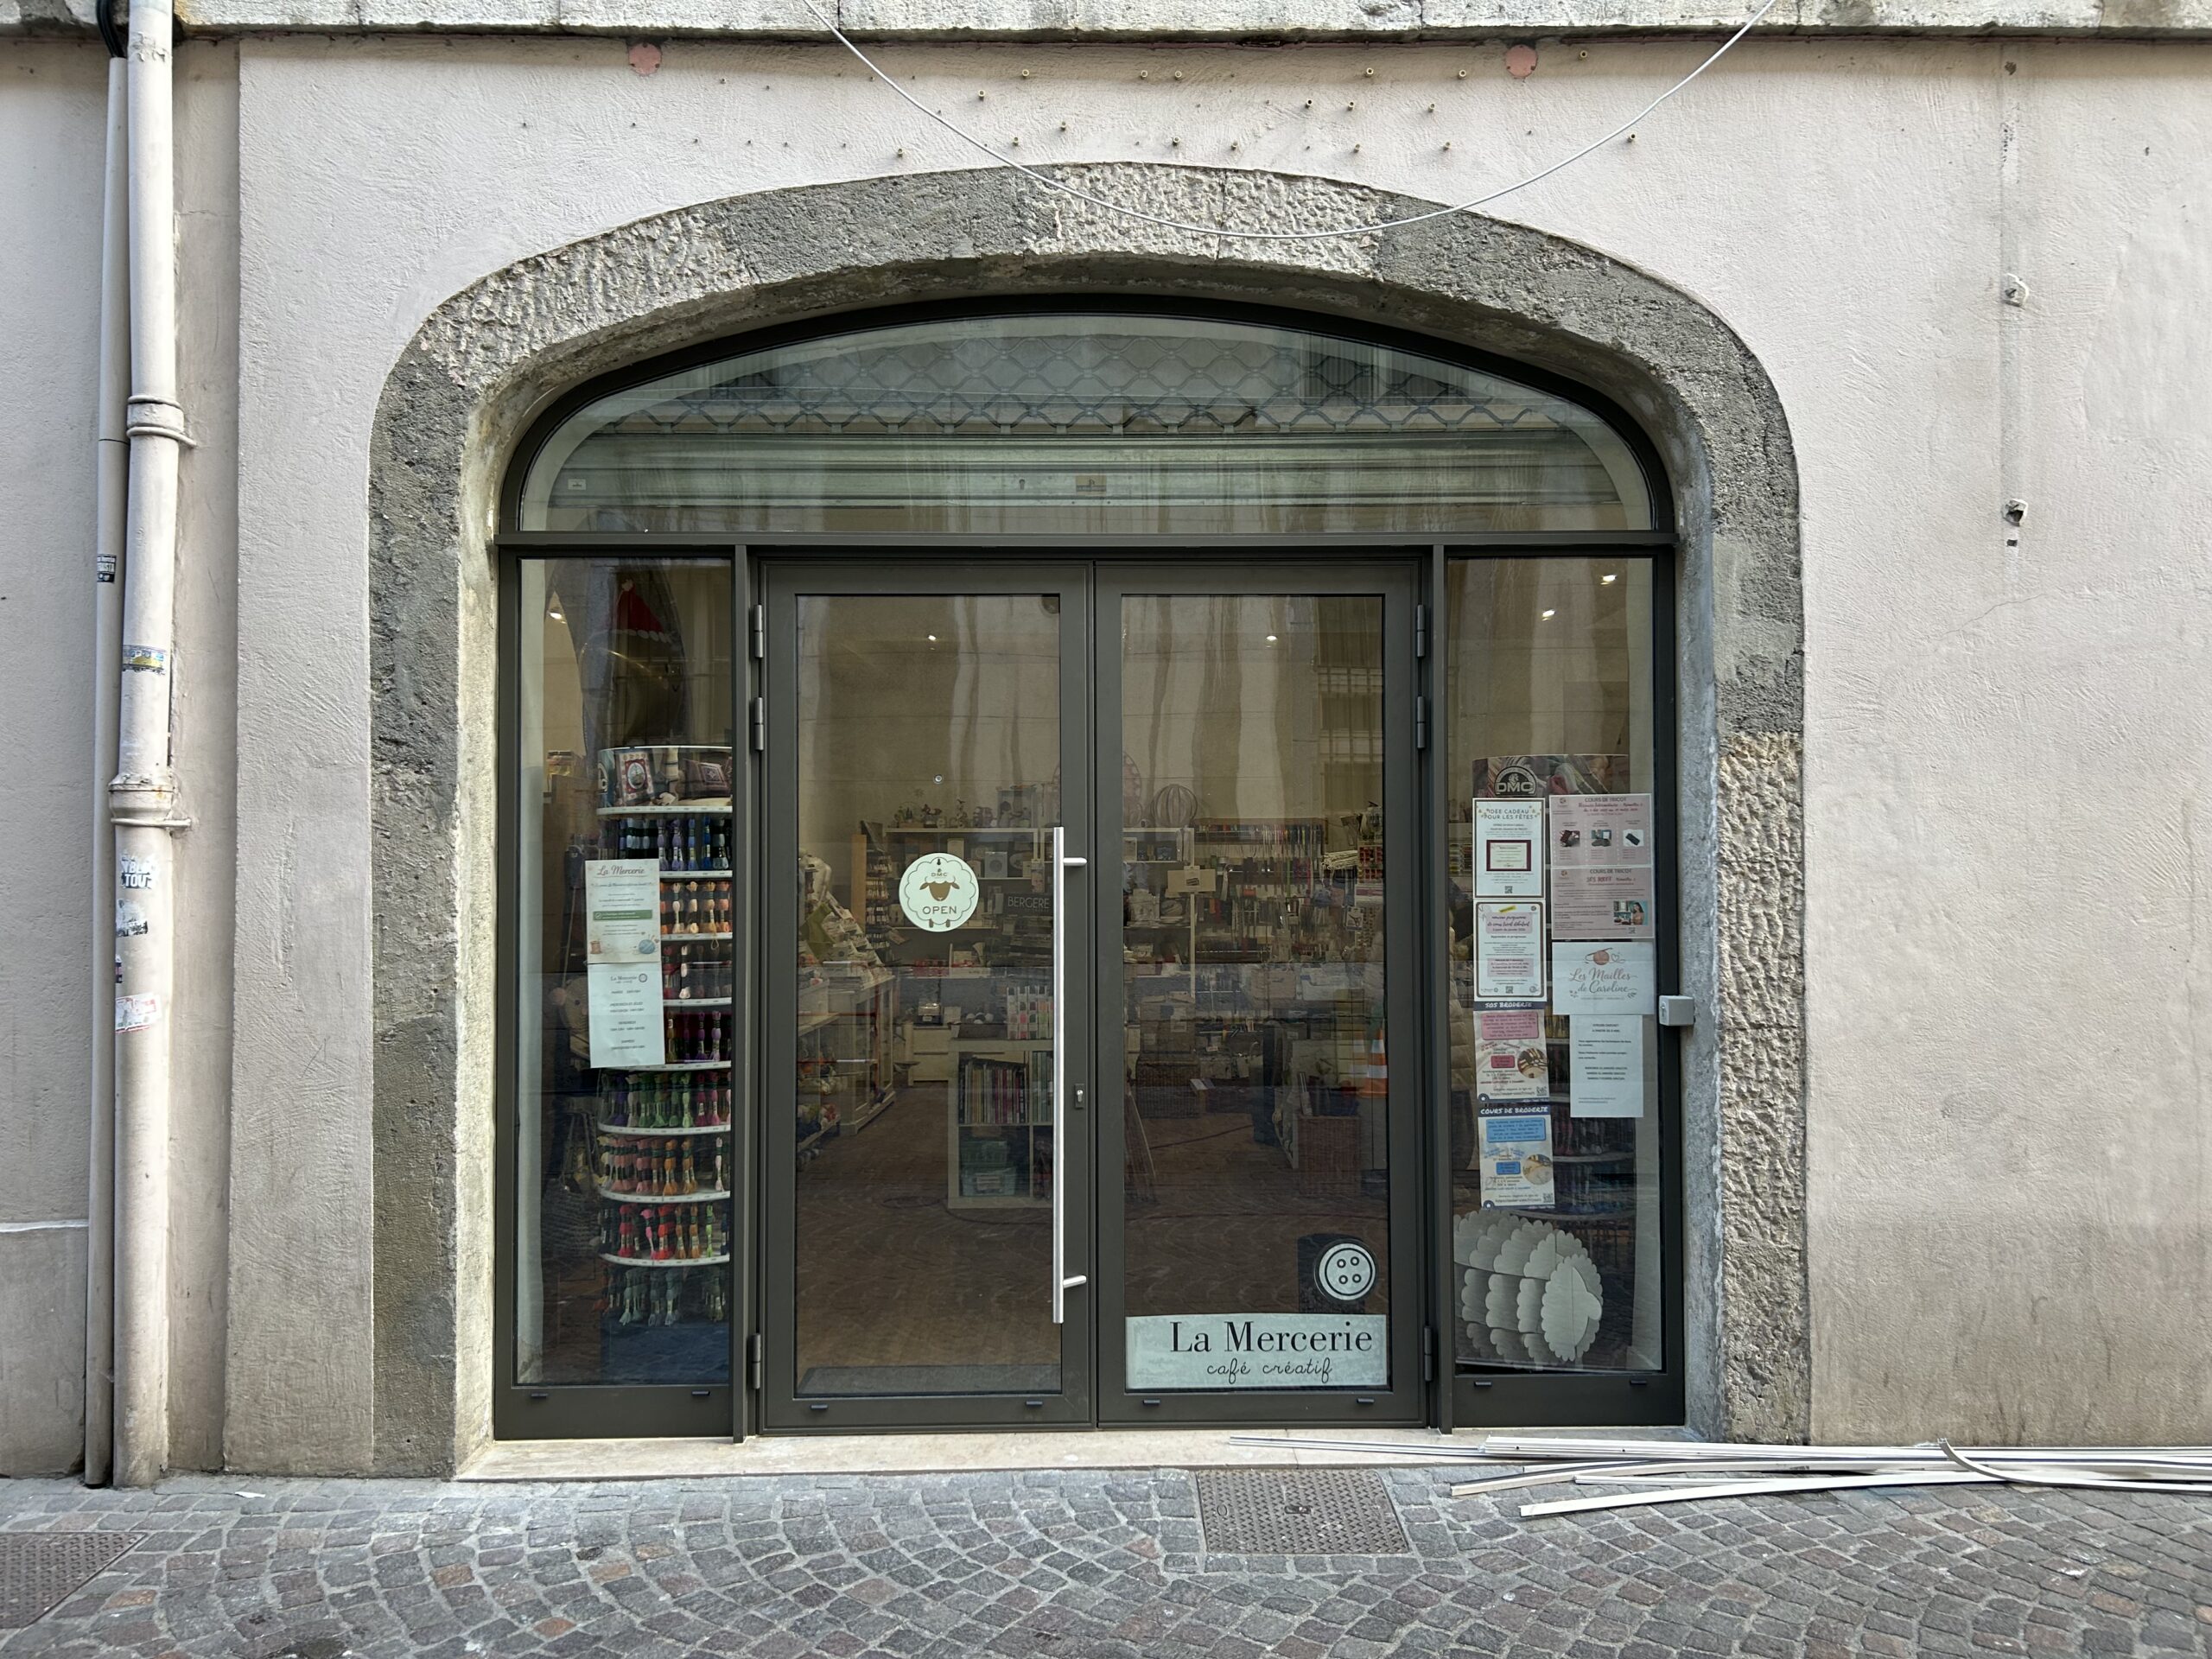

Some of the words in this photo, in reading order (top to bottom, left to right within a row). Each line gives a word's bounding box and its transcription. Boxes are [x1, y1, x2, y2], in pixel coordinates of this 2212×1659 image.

[1497, 781, 1534, 792] DMC
[597, 865, 608, 876] La
[611, 864, 645, 875] Mercerie
[1007, 896, 1050, 908] BERGERE
[922, 906, 957, 915] OPEN
[1569, 968, 1586, 982] Les
[1588, 967, 1638, 982] Mailles
[1578, 982, 1586, 993] de
[1589, 981, 1637, 994] Caroline
[1170, 1320, 1211, 1352] La
[1224, 1320, 1372, 1352] Mercerie
[1207, 1357, 1251, 1384] café
[1262, 1357, 1332, 1383] créatif
